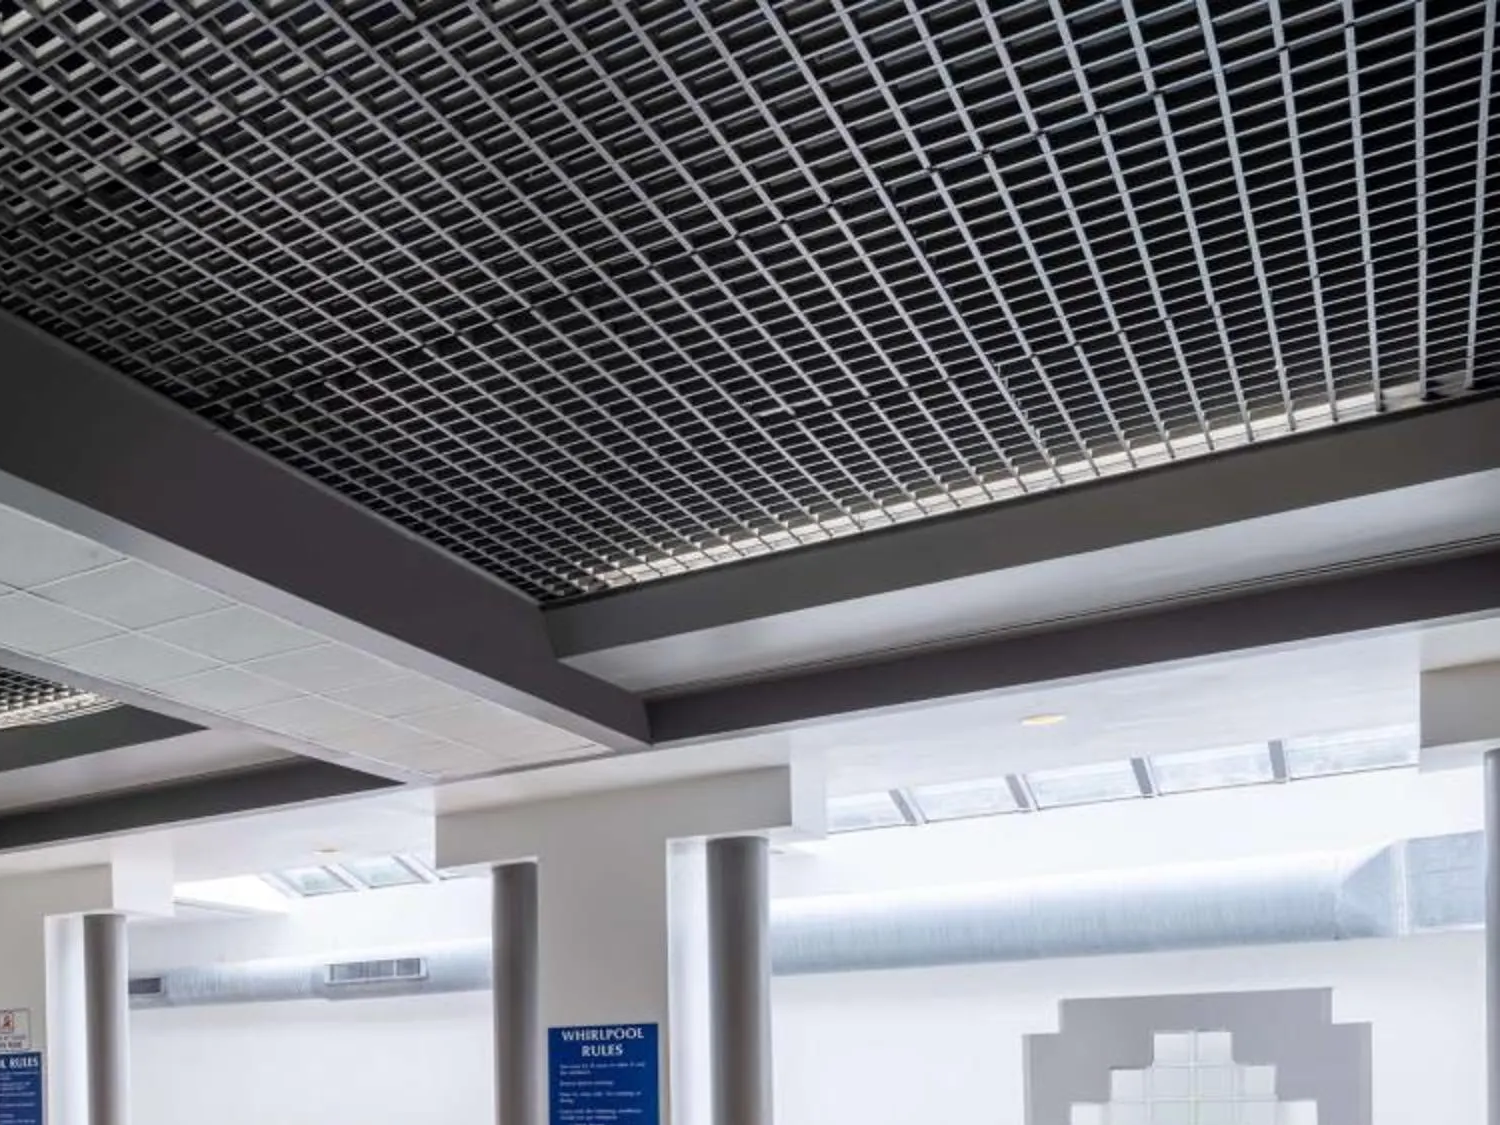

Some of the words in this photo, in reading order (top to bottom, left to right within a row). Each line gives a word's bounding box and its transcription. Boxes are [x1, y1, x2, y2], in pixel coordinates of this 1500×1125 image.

[561, 1027, 645, 1041] WHIRLPOOL
[581, 1043, 624, 1057] RULES
[9, 1056, 38, 1068] RULES
